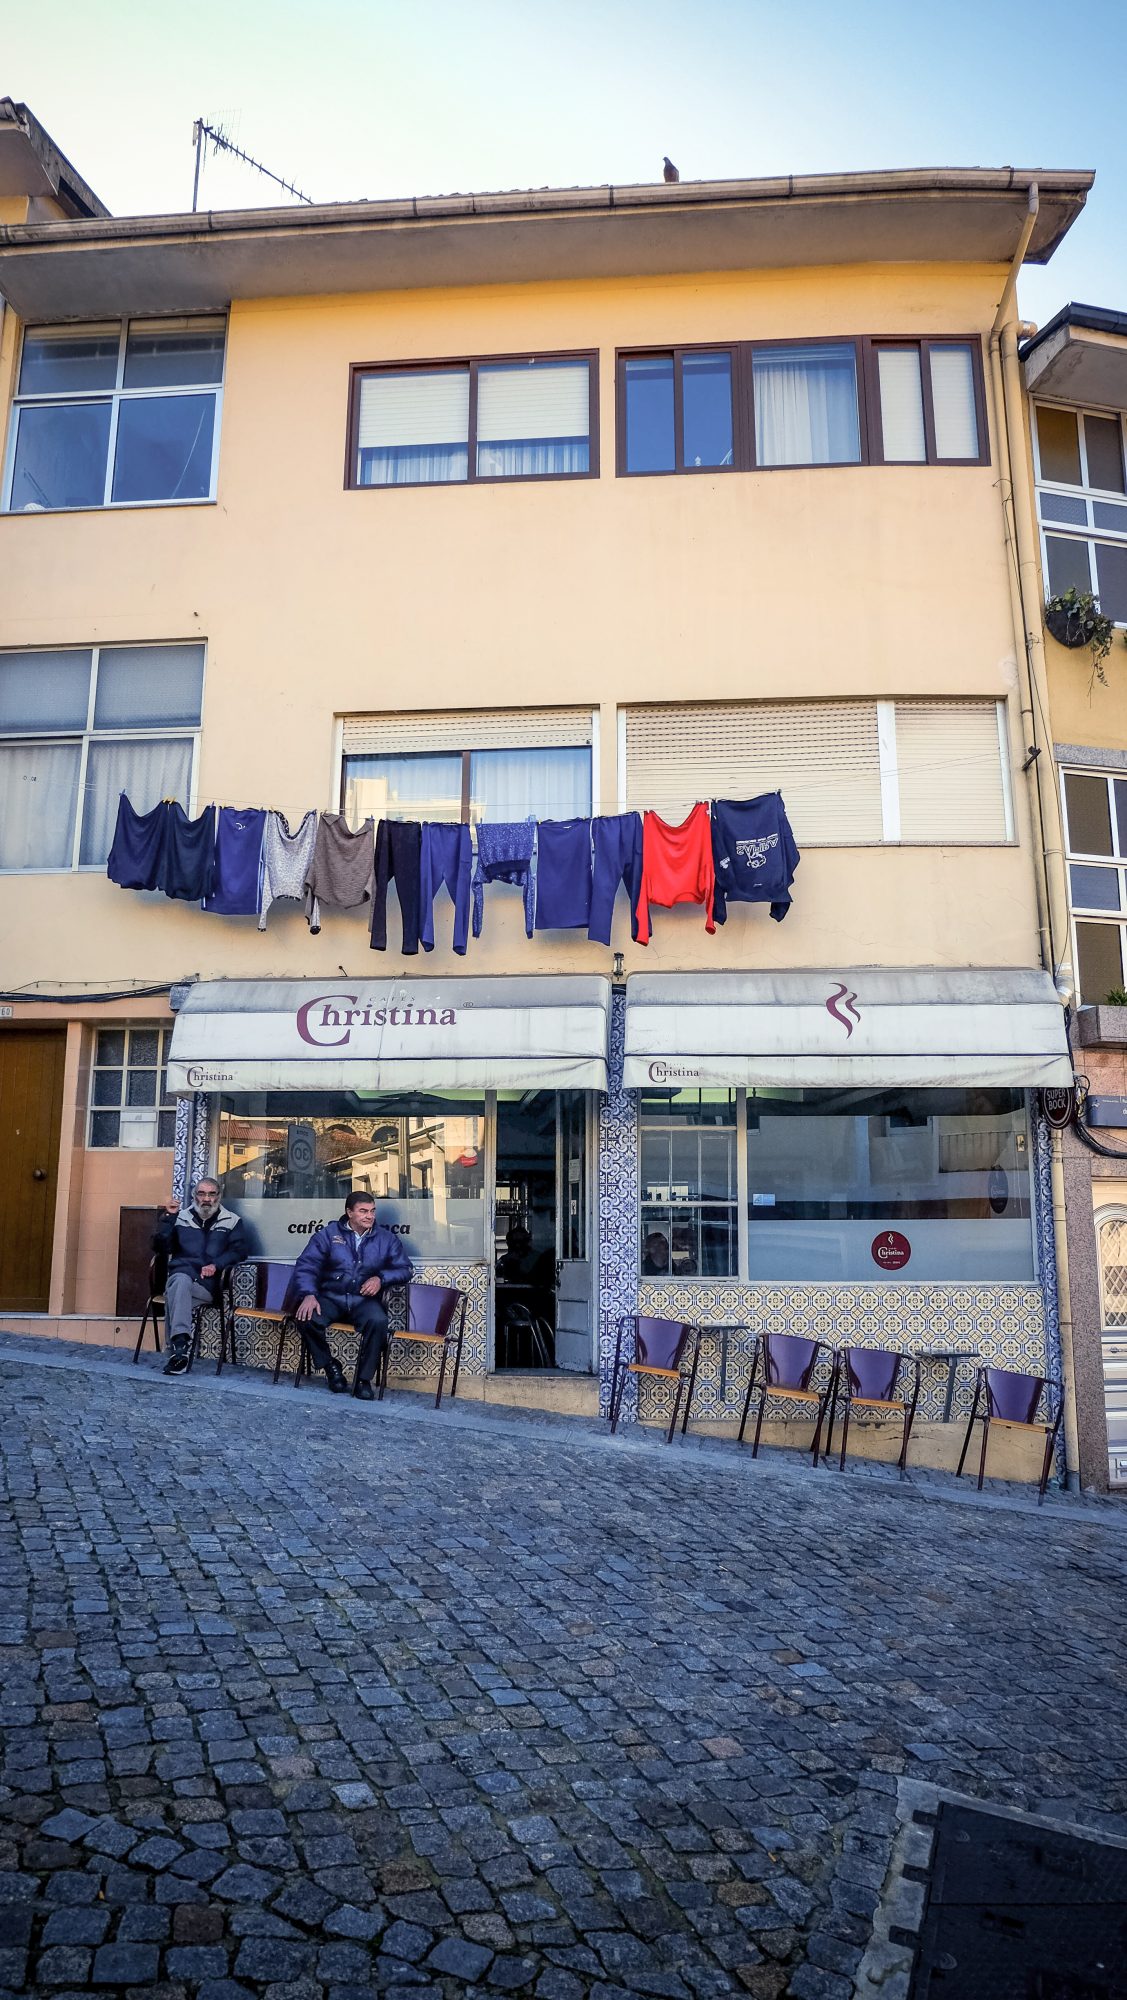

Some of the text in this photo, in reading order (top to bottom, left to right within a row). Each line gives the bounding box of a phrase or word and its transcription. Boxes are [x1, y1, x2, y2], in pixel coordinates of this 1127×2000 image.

[297, 995, 457, 1046] Christina
[187, 1066, 233, 1087] Christina
[648, 1061, 700, 1083] Christina
[1046, 1088, 1066, 1100] SUPER
[1048, 1098, 1067, 1110] BOCK
[288, 1219, 325, 1234] café
[878, 1246, 905, 1259] Christina
